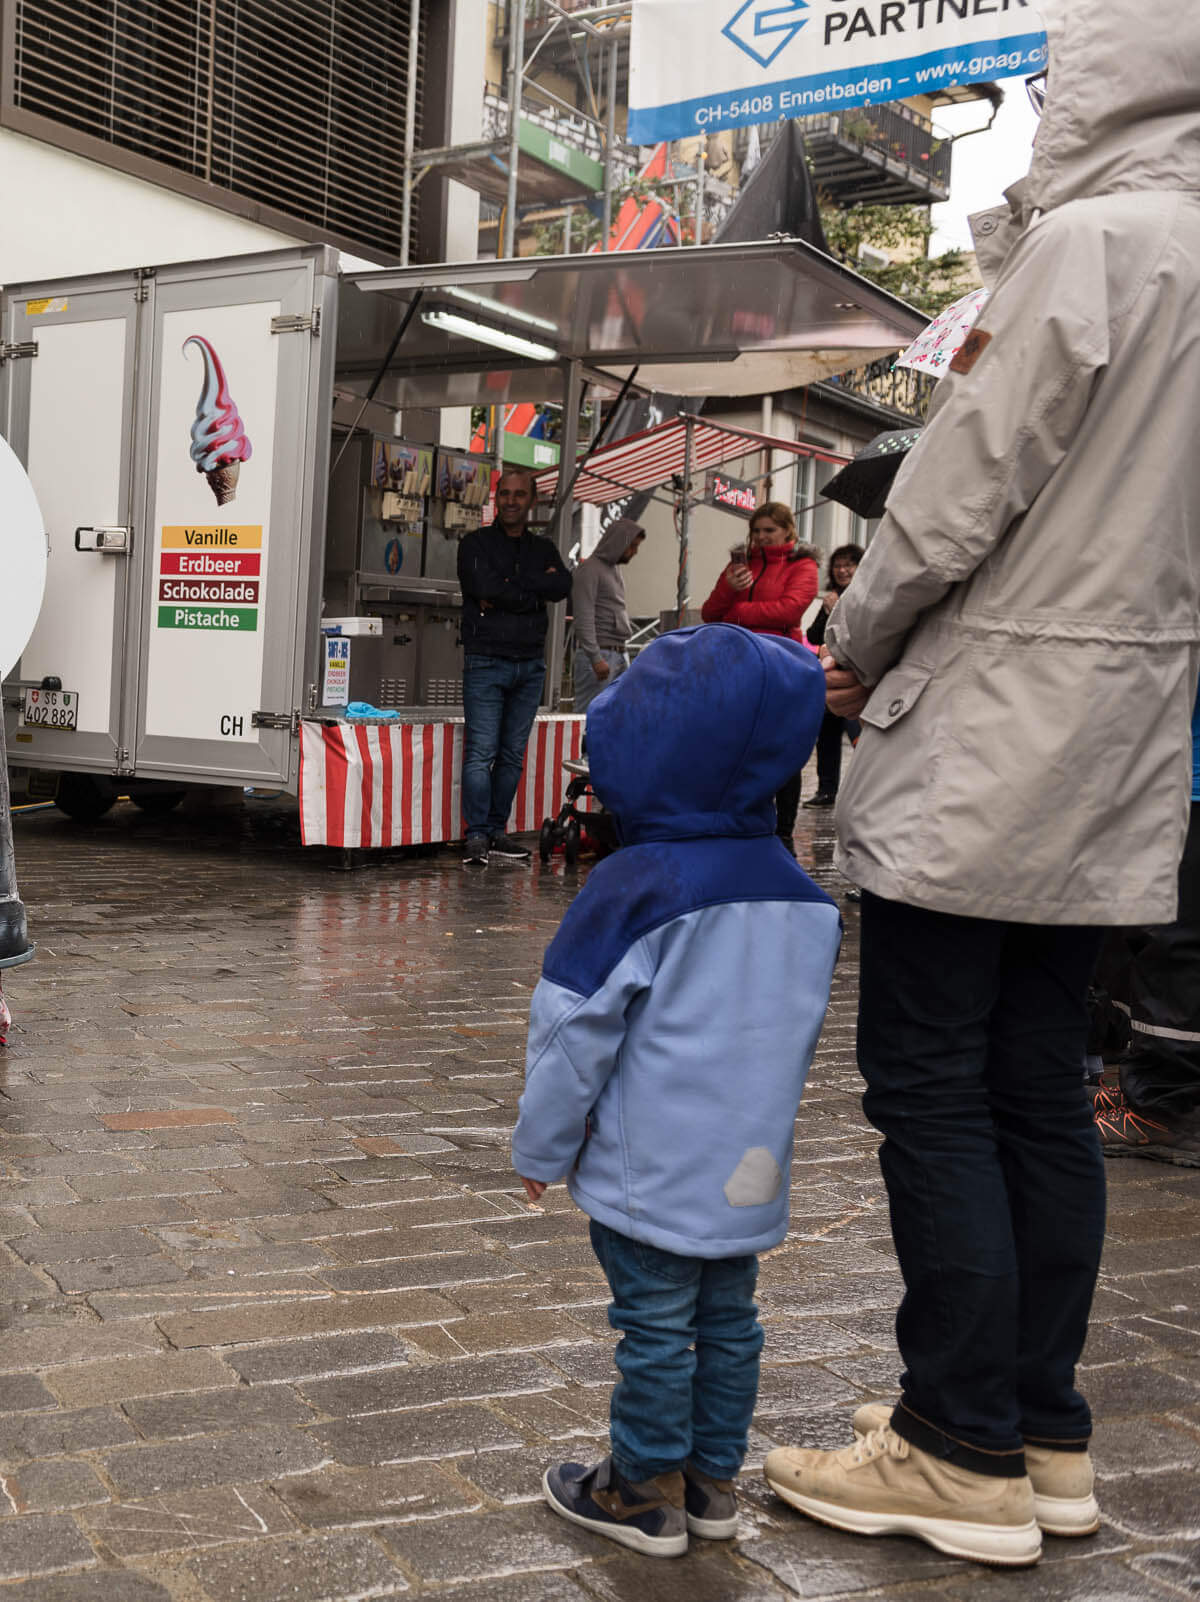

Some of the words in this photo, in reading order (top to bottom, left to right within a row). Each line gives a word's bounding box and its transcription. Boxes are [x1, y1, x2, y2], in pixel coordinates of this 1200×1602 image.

[694, 91, 773, 126] CH-5408
[779, 73, 892, 109] Ennetbaden
[184, 528, 238, 545] Vanille
[179, 555, 241, 573] Erdbeer
[163, 581, 255, 600] Schokolade
[175, 608, 240, 627] Pistache
[44, 692, 57, 705] SG
[27, 706, 48, 723] 402
[51, 709, 74, 727] 882
[221, 715, 243, 736] CH
